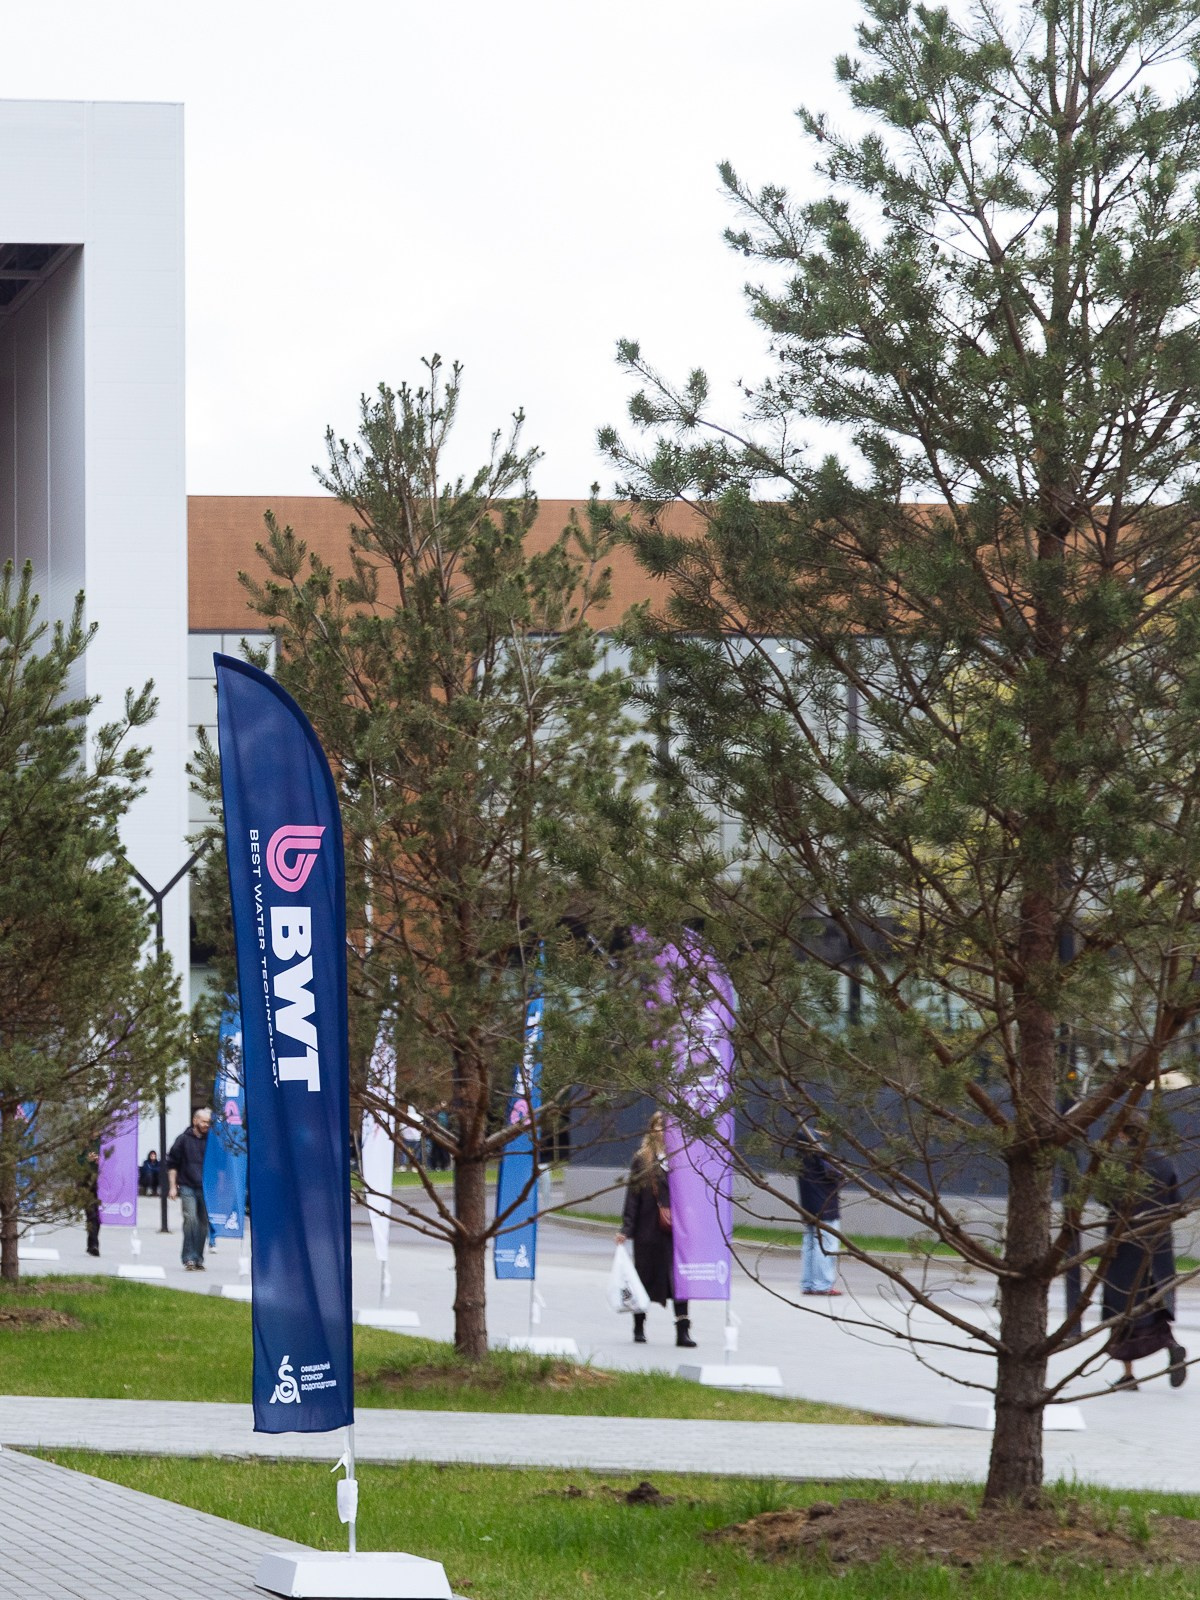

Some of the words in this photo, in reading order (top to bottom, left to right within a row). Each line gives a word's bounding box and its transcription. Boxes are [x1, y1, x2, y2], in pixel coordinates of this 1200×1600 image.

[249, 829, 261, 877] BEST
[253, 883, 266, 950] WATER
[270, 906, 321, 1092] BWT
